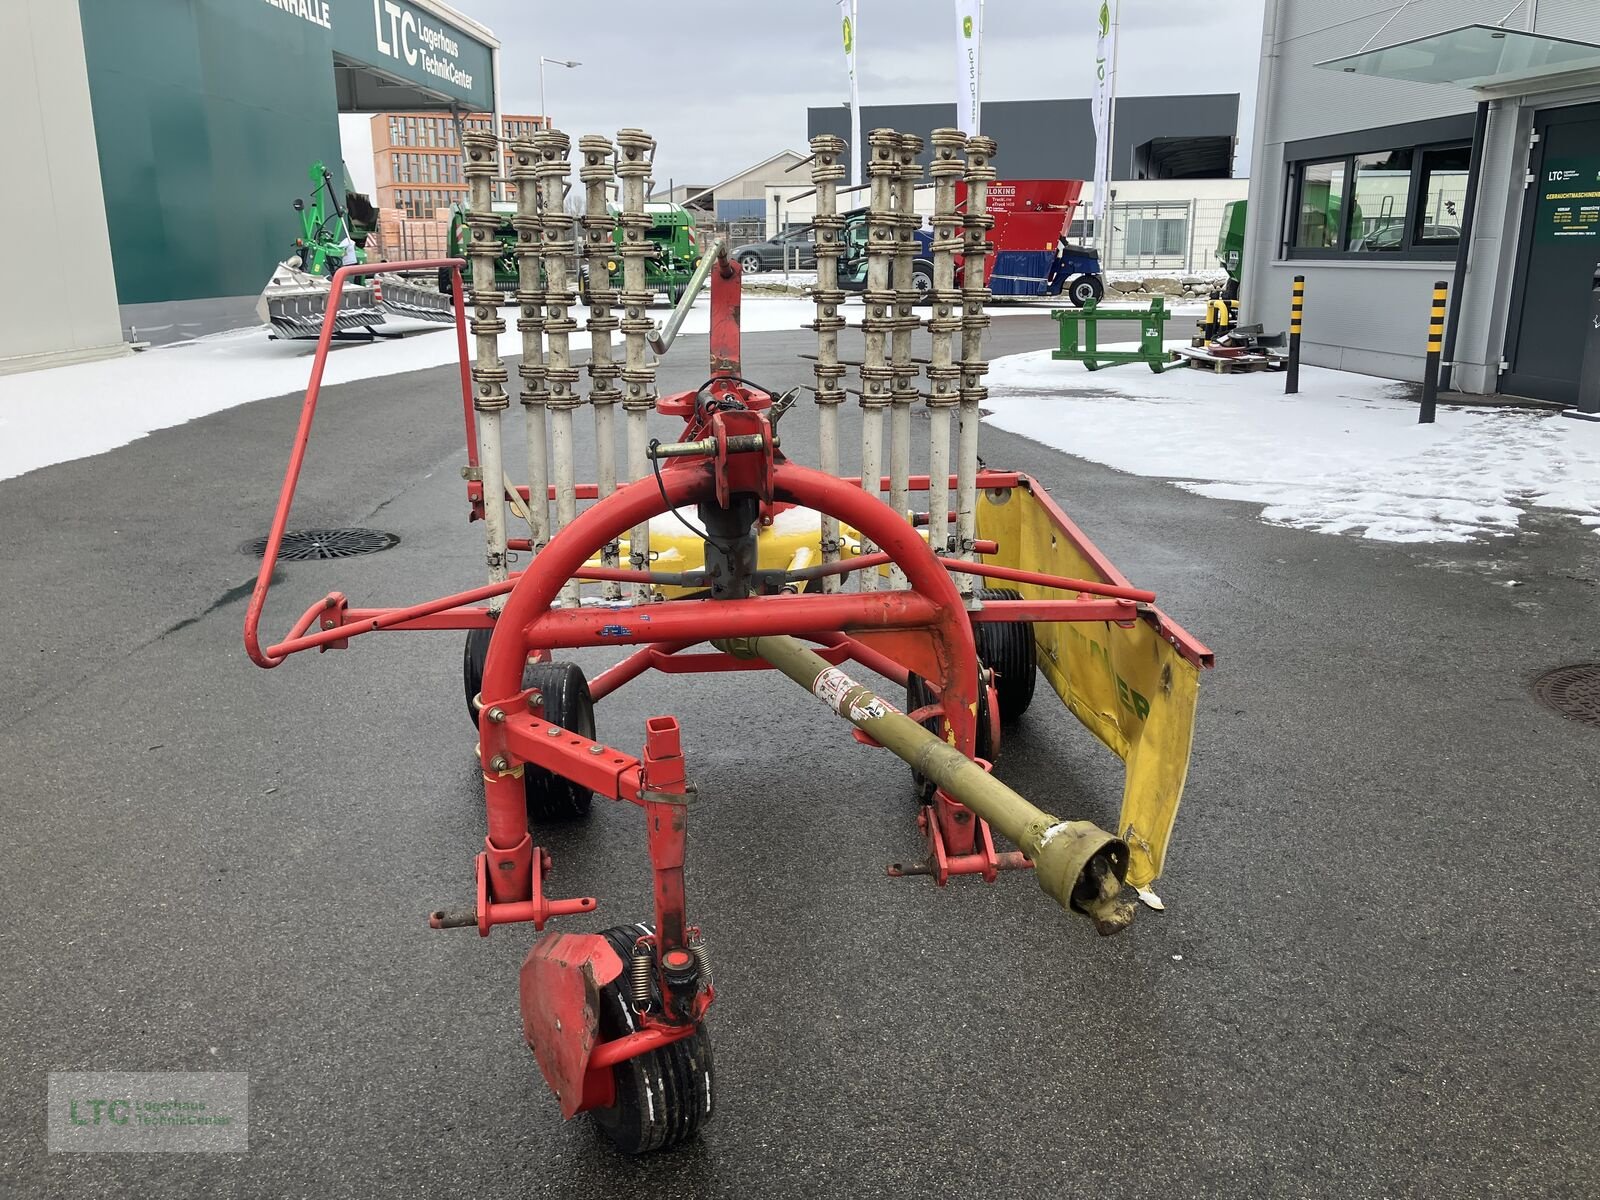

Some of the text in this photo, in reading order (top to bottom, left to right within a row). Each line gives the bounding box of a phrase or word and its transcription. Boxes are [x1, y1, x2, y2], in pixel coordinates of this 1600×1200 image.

[373, 0, 418, 66] LTC
[418, 17, 459, 58] Lagerhaus
[420, 47, 473, 90] TechnikCenter
[1548, 171, 1562, 181] LTC
